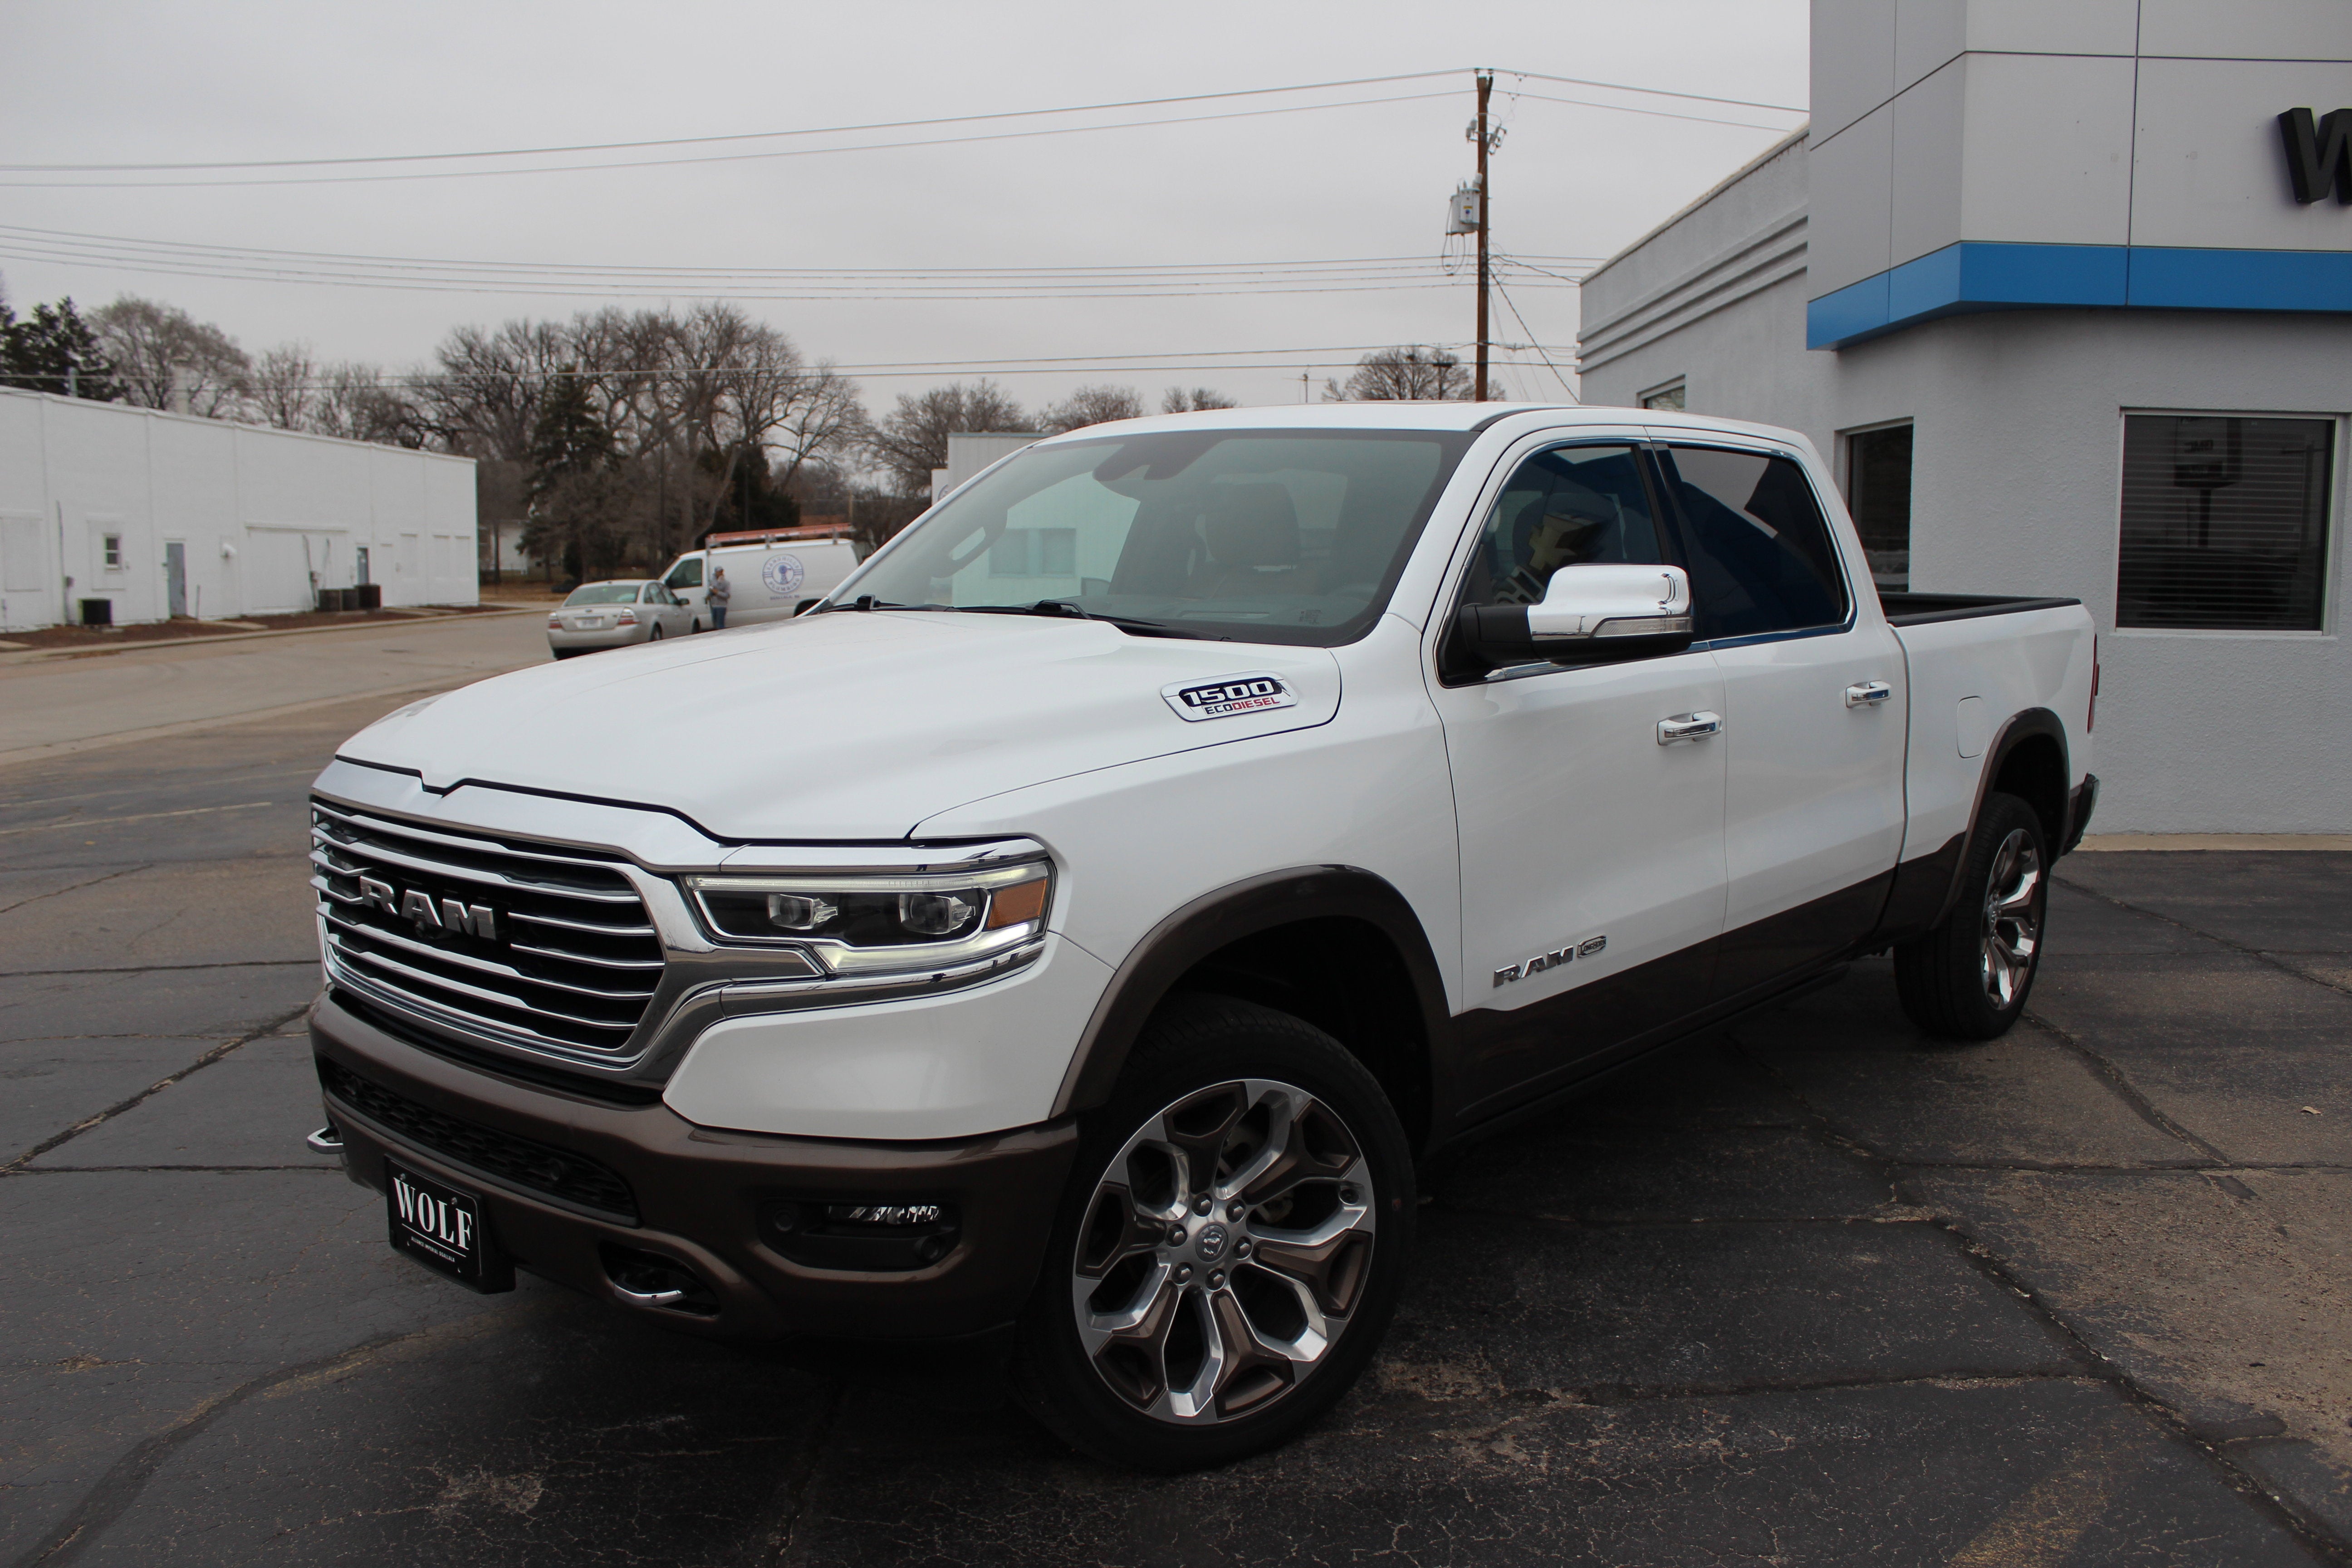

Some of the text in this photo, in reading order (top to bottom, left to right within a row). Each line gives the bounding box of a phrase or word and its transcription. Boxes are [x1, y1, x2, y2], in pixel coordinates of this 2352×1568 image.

[1185, 681, 1274, 705] 1500
[1205, 697, 1280, 715] ECODIESEL
[360, 875, 496, 940] RAM
[1493, 939, 1606, 988] RAM LONGHORN
[393, 1177, 472, 1250] WOLF
